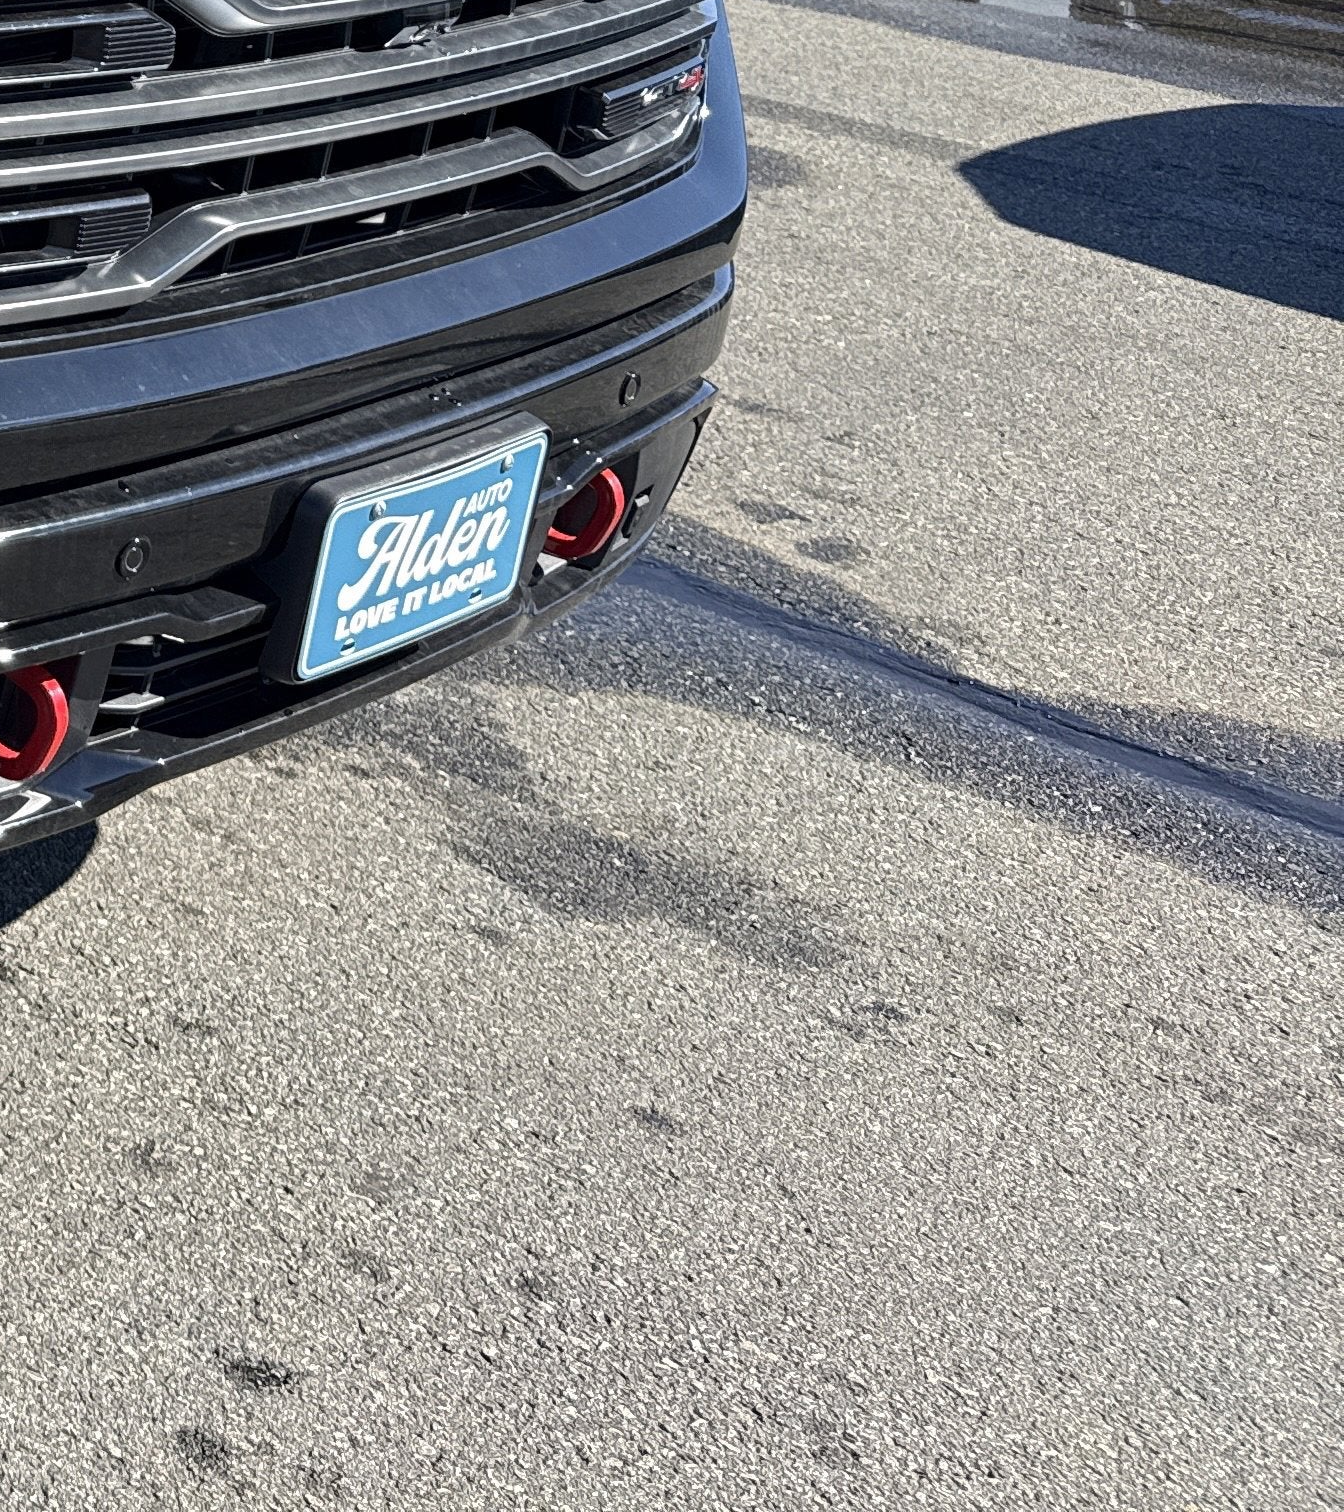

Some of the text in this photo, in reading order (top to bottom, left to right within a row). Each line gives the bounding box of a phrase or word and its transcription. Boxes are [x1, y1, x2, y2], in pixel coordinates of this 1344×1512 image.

[462, 477, 513, 518] AUTO
[337, 496, 511, 612] Alden
[334, 557, 497, 641] LOVE IT LOCAL
